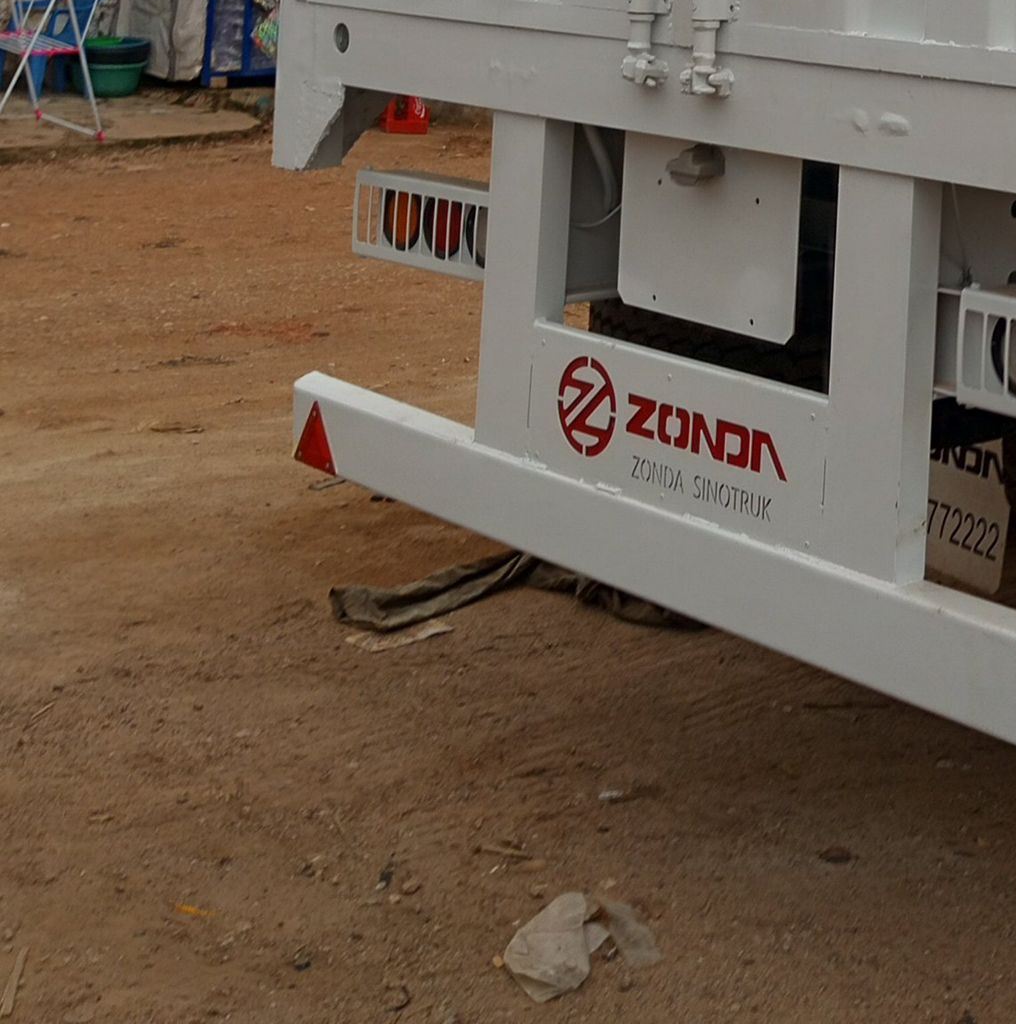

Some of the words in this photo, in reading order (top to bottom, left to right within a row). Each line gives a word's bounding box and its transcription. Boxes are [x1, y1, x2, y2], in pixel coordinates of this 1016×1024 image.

[625, 392, 788, 483] ZONDA
[630, 455, 685, 495] ZONDA
[692, 474, 773, 523] SINOTRUK
